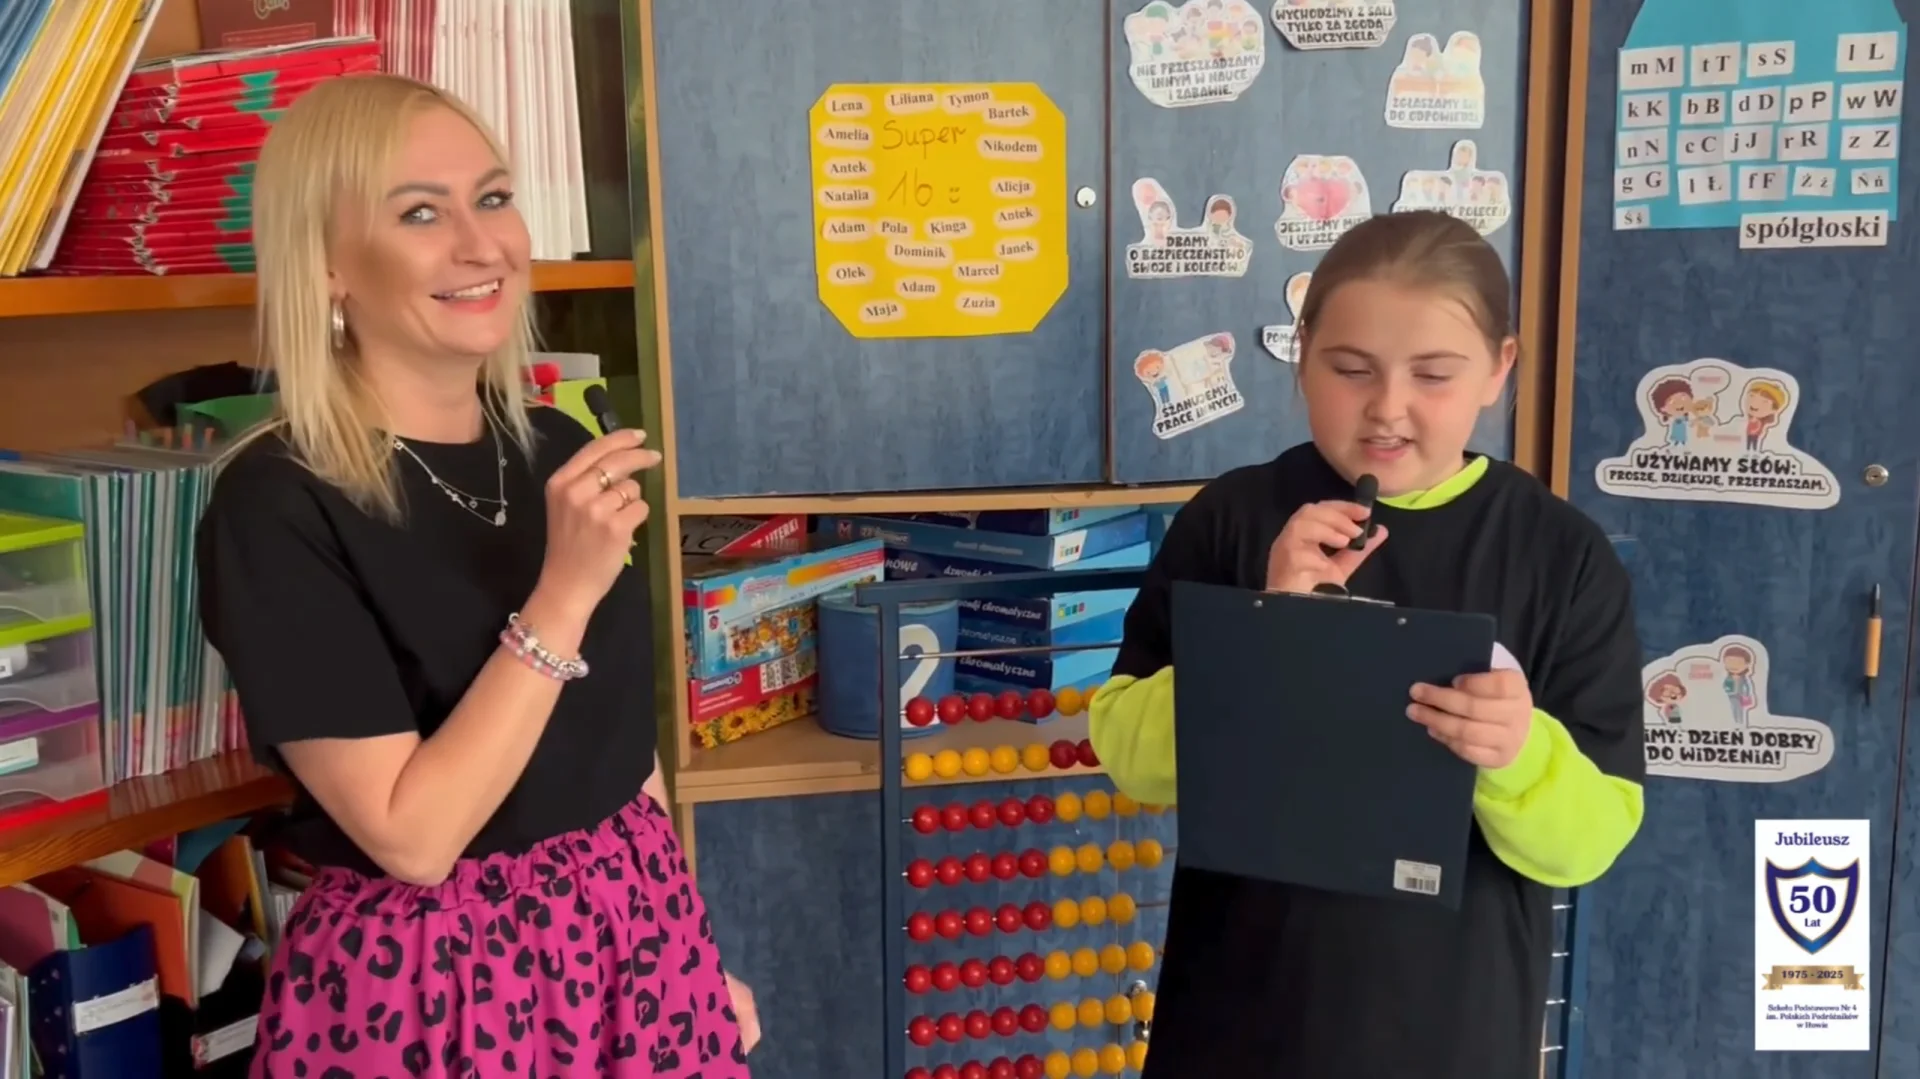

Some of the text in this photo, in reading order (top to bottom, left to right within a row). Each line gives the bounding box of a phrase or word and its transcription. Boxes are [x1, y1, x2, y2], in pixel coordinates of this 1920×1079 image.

[1276, 6, 1354, 20] WYCHODZIMY
[1358, 6, 1364, 16] Z
[1287, 21, 1322, 32] TYLKO
[1326, 20, 1341, 30] ZA
[1137, 55, 1260, 76] NIE PRZESZKADZAMY
[1152, 69, 1248, 88] INNYM W NAUCE
[890, 92, 934, 106] Liliana
[948, 91, 989, 108] Tymon
[832, 100, 863, 112] Lena
[988, 106, 1029, 119] Bartek
[1389, 110, 1405, 121] DO
[824, 129, 869, 141] Amelia
[882, 120, 966, 160] Super
[984, 140, 1038, 152] Nikodem
[830, 162, 867, 174] Antek
[995, 181, 1030, 194] Alicja
[824, 190, 869, 202] Natalia
[998, 208, 1033, 221] Antek
[829, 222, 865, 234] Adam
[881, 222, 908, 234] Pola
[930, 221, 966, 235] Kinga
[1746, 216, 1880, 244] spółgłoski
[1166, 236, 1209, 247] DBAMY
[894, 246, 946, 258] Dominik
[999, 242, 1034, 255] Janek
[1130, 250, 1138, 260] O
[836, 267, 866, 280] Olek
[957, 265, 999, 277] Marcel
[1133, 262, 1172, 273] SWOJE
[900, 282, 936, 293] Adam
[962, 298, 995, 309] Zuzia
[866, 304, 898, 318] Maja
[1162, 384, 1228, 418] SZANUJEMY
[1636, 452, 1796, 475] UŻYWAMY SŁÓW:
[1688, 729, 1744, 746] DZIEŃ
[1750, 732, 1816, 749] DOBRY
[1649, 747, 1780, 765] DO WIDZENIA!
